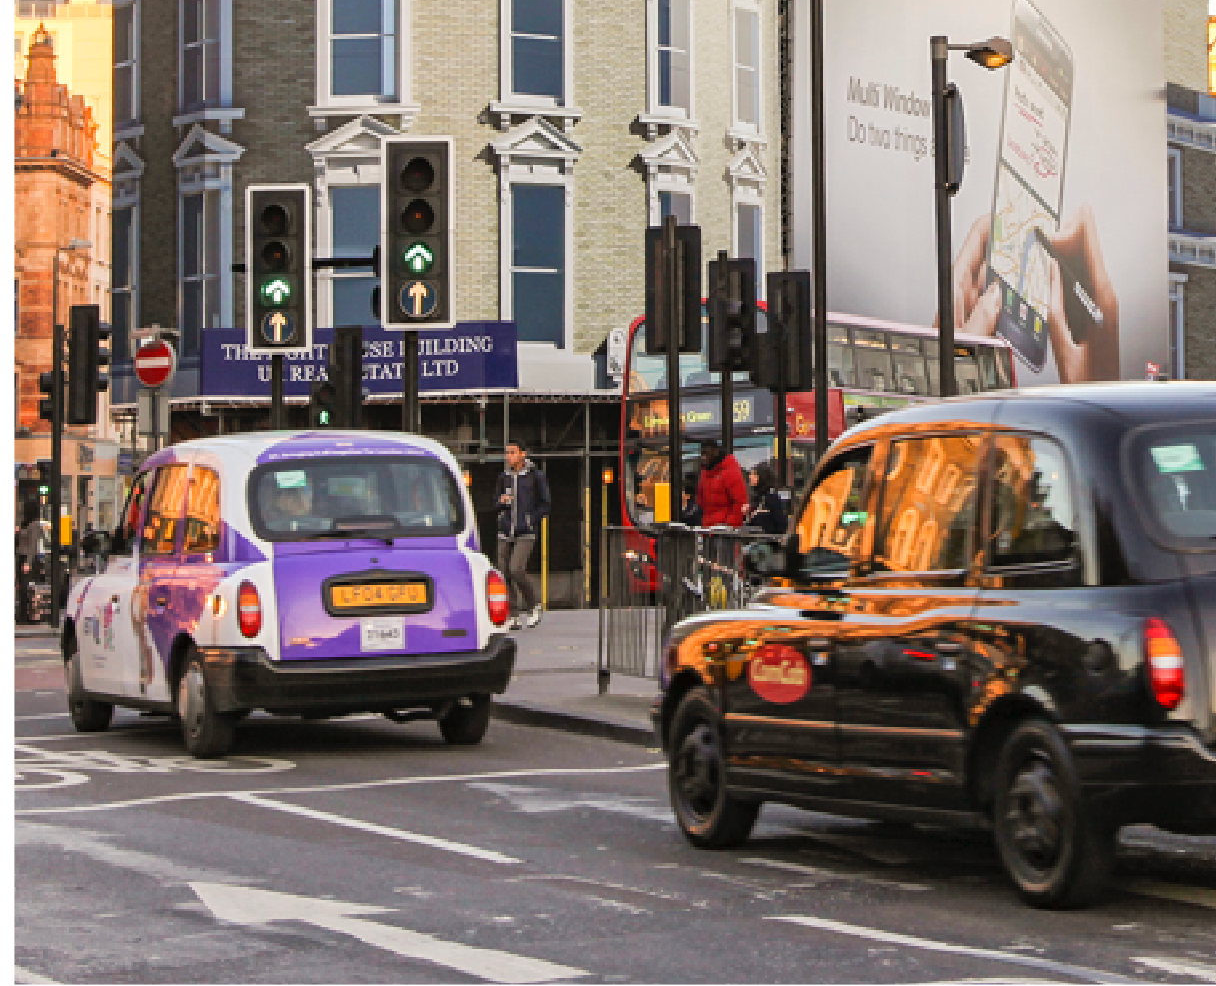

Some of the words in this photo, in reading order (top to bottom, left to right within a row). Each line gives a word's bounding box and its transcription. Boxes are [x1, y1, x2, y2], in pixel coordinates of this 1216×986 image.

[846, 115, 866, 143] Do
[399, 335, 494, 357] ILDING
[289, 363, 330, 382] REA
[422, 359, 460, 378] LTD
